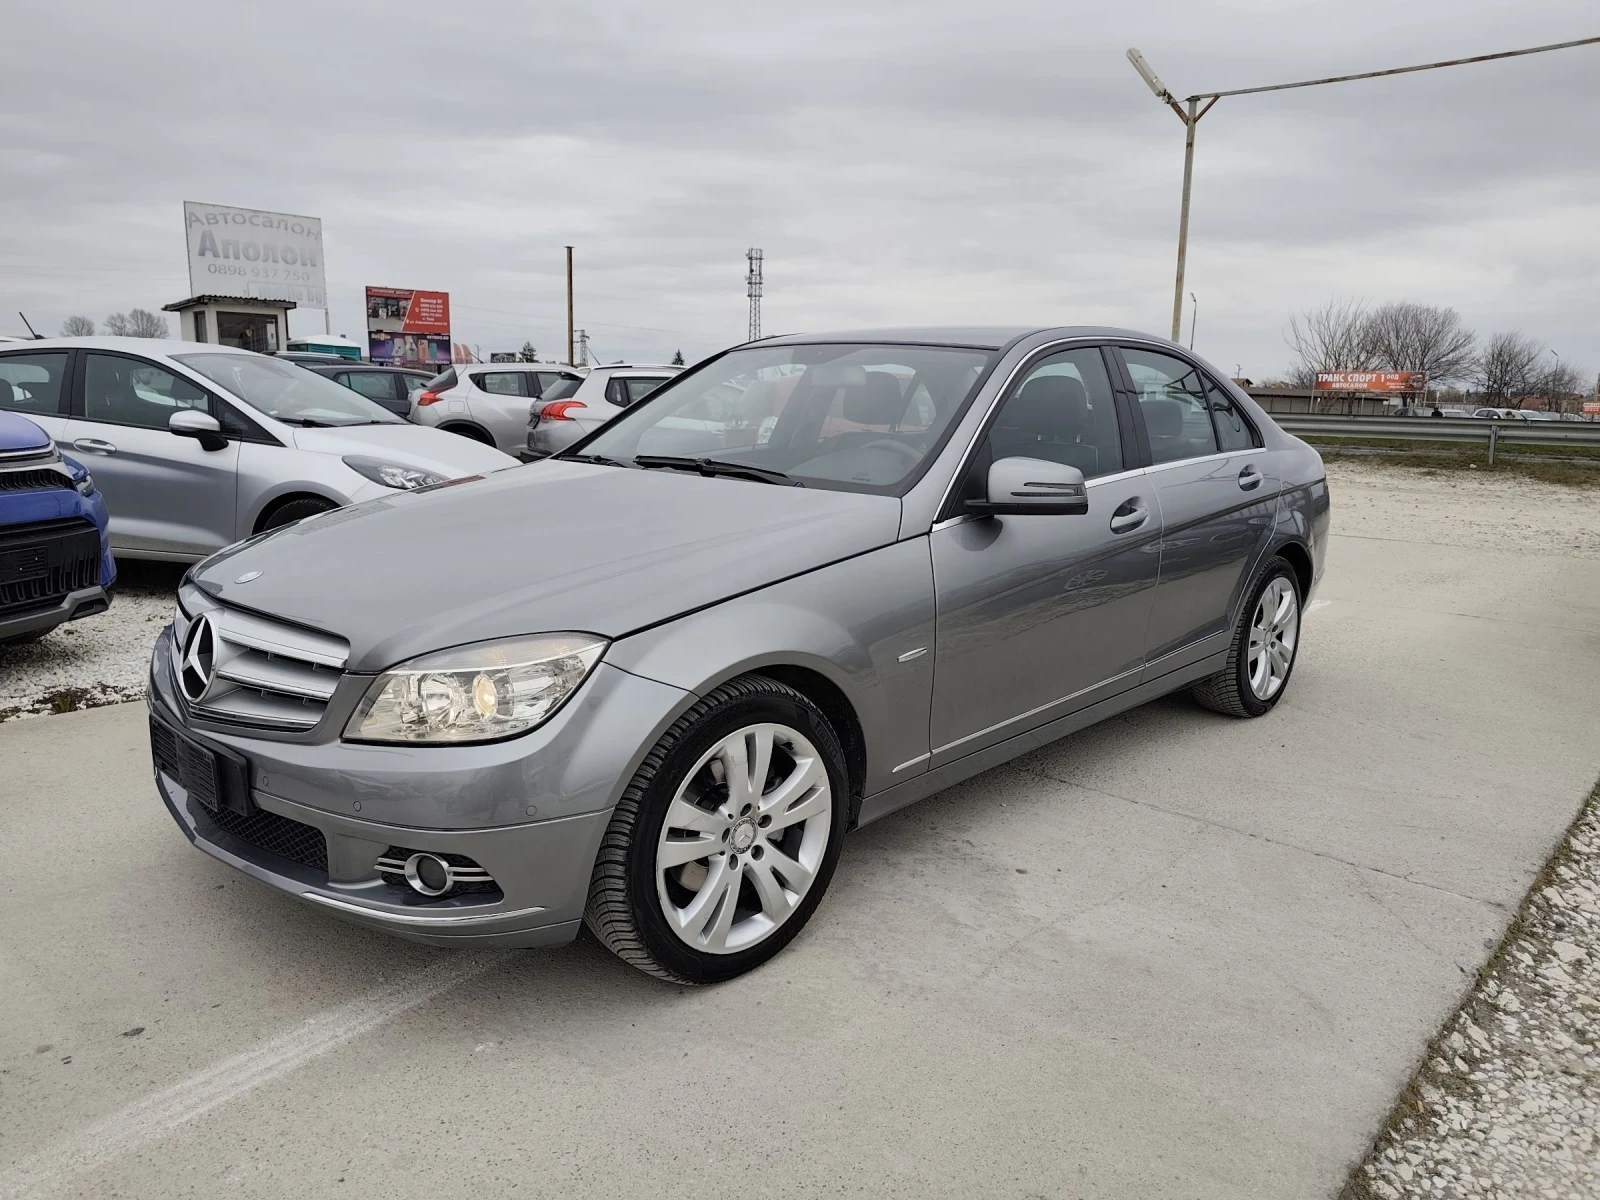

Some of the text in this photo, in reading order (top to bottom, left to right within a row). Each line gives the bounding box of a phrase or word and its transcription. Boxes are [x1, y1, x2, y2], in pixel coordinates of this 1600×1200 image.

[189, 210, 320, 241] Автосалон
[198, 229, 317, 268] Аполон
[207, 263, 310, 281] 0898 937 750
[1318, 373, 1344, 382] ТРАНС
[1347, 373, 1376, 382] СПОРТ
[1380, 373, 1385, 382] 1
